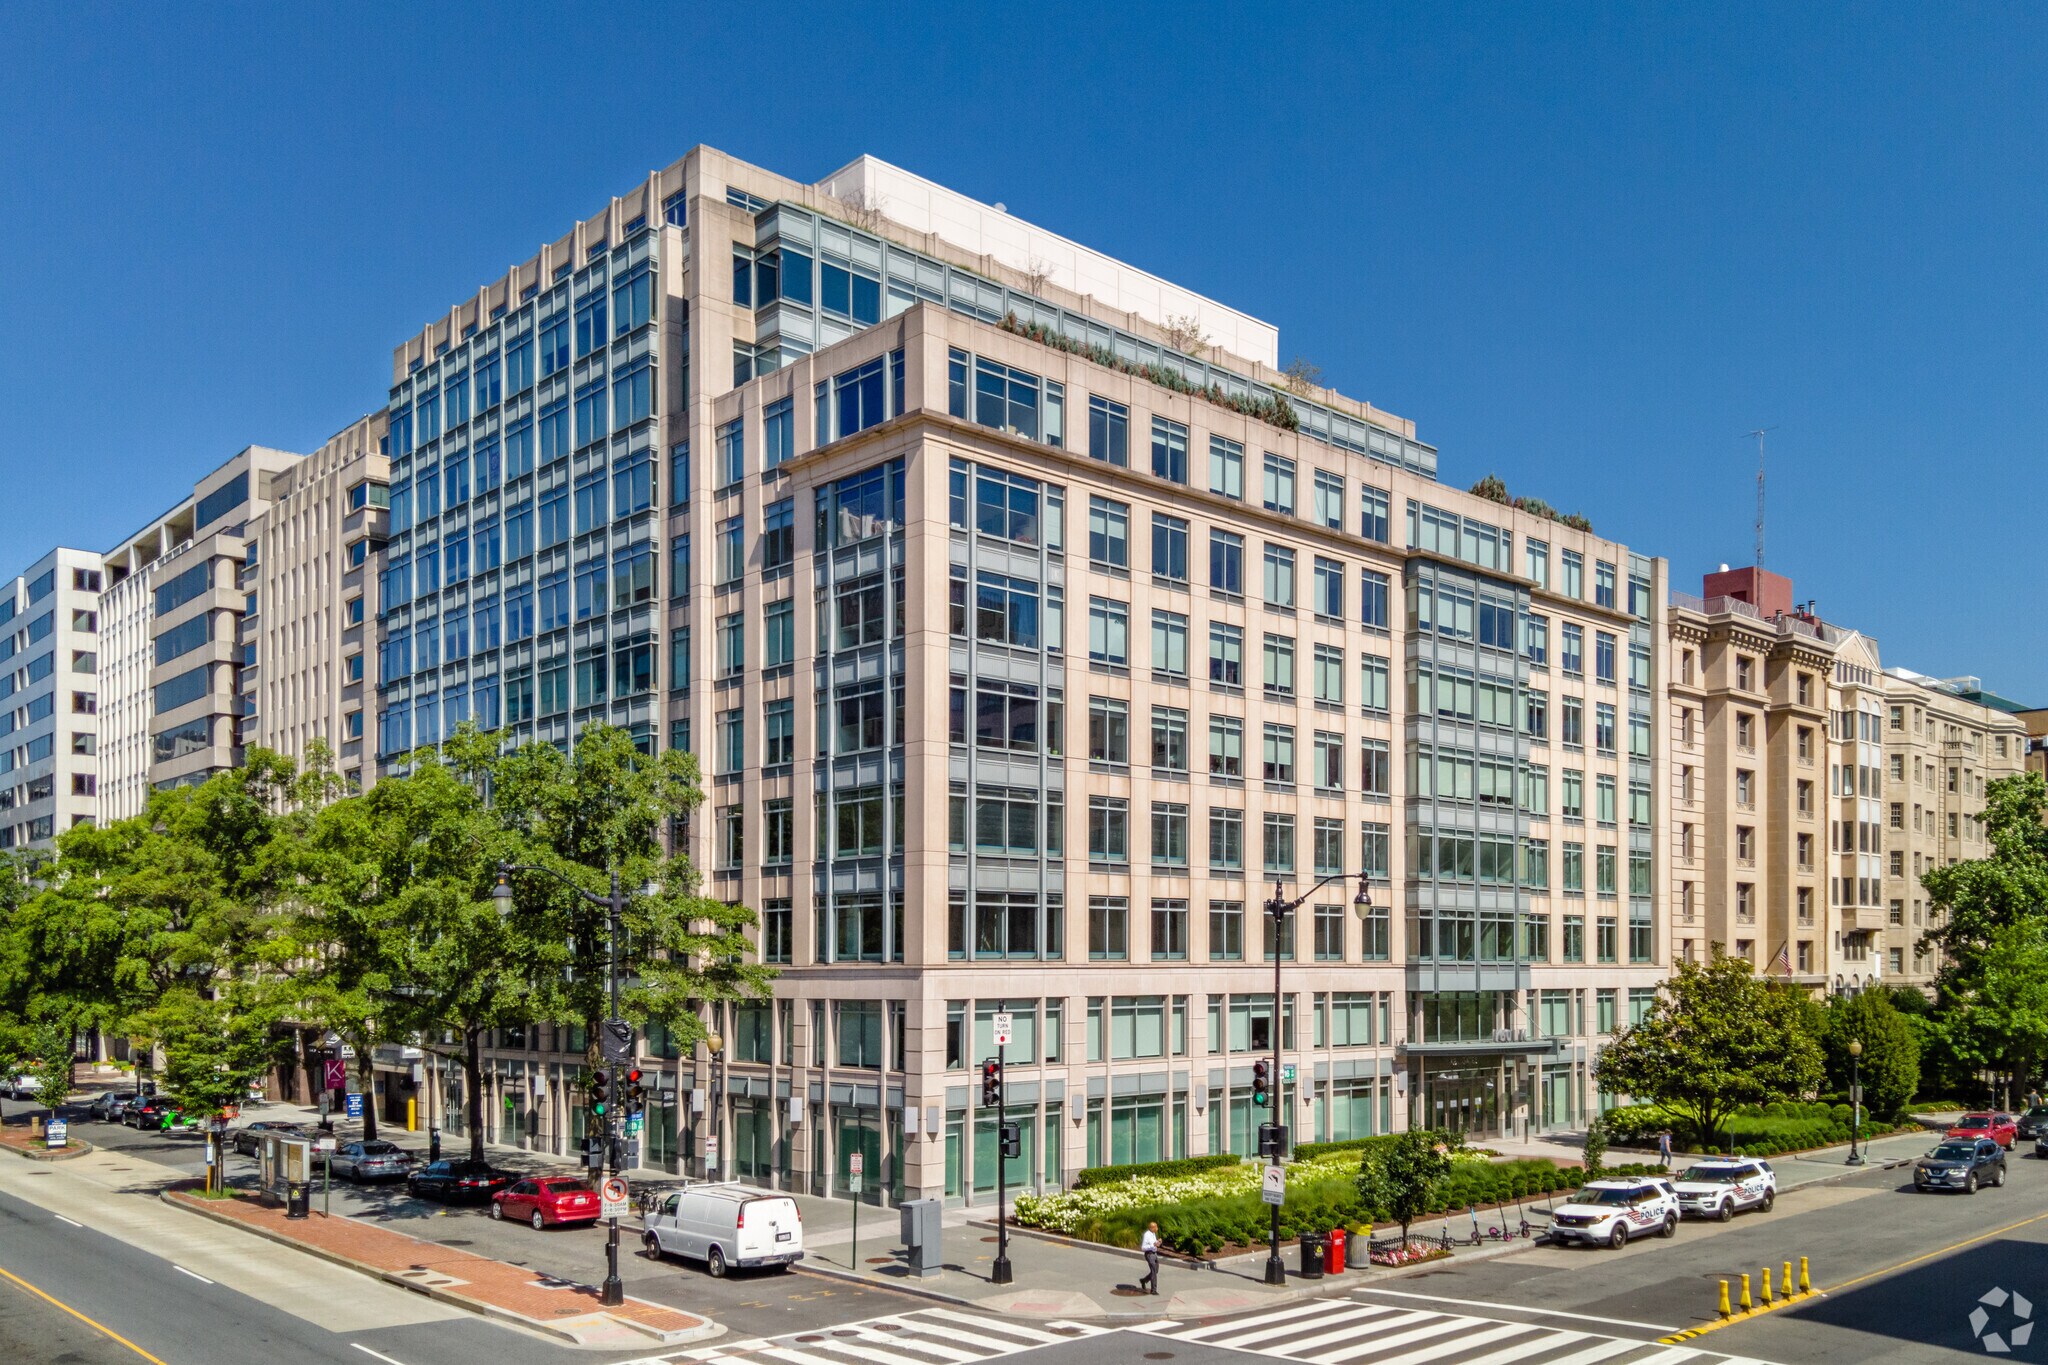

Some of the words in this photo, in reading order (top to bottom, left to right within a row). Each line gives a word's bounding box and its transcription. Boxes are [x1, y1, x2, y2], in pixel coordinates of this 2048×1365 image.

[327, 1062, 343, 1080] K
[1744, 1184, 1764, 1195] POLICE
[1640, 1207, 1665, 1220] POLICE
